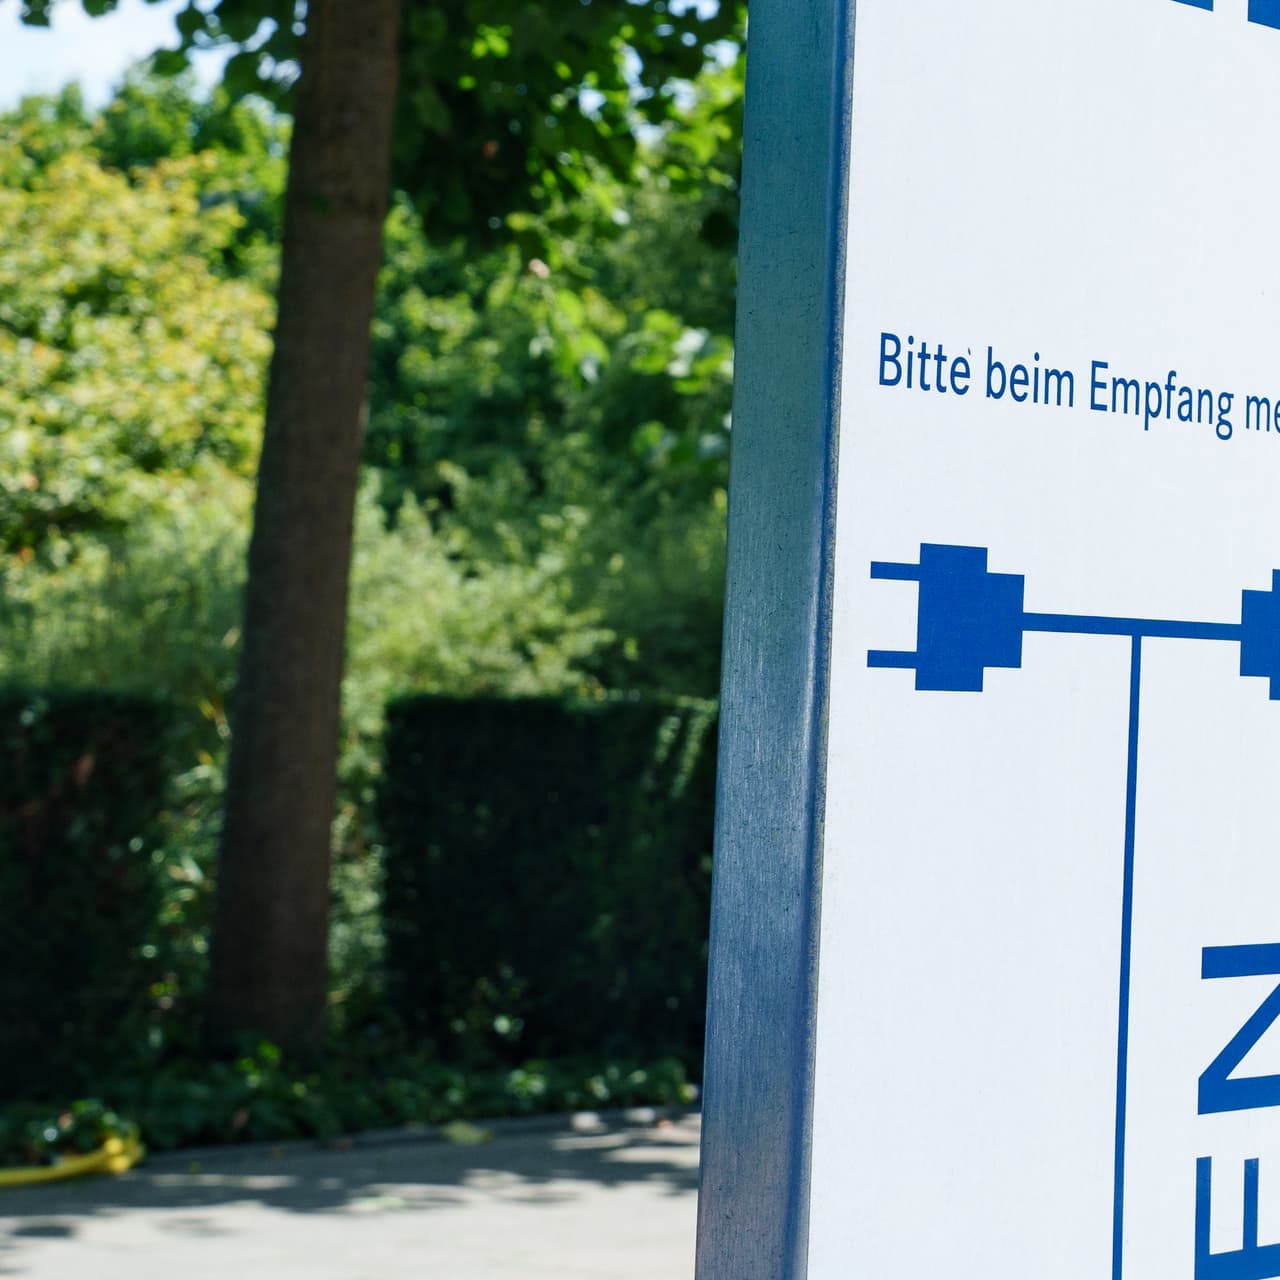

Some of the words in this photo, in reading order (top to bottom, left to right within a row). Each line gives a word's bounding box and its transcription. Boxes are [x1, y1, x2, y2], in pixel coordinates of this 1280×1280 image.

[880, 333, 971, 396] Bitte
[986, 347, 1075, 408] beim
[1090, 361, 1235, 442] Empfang
